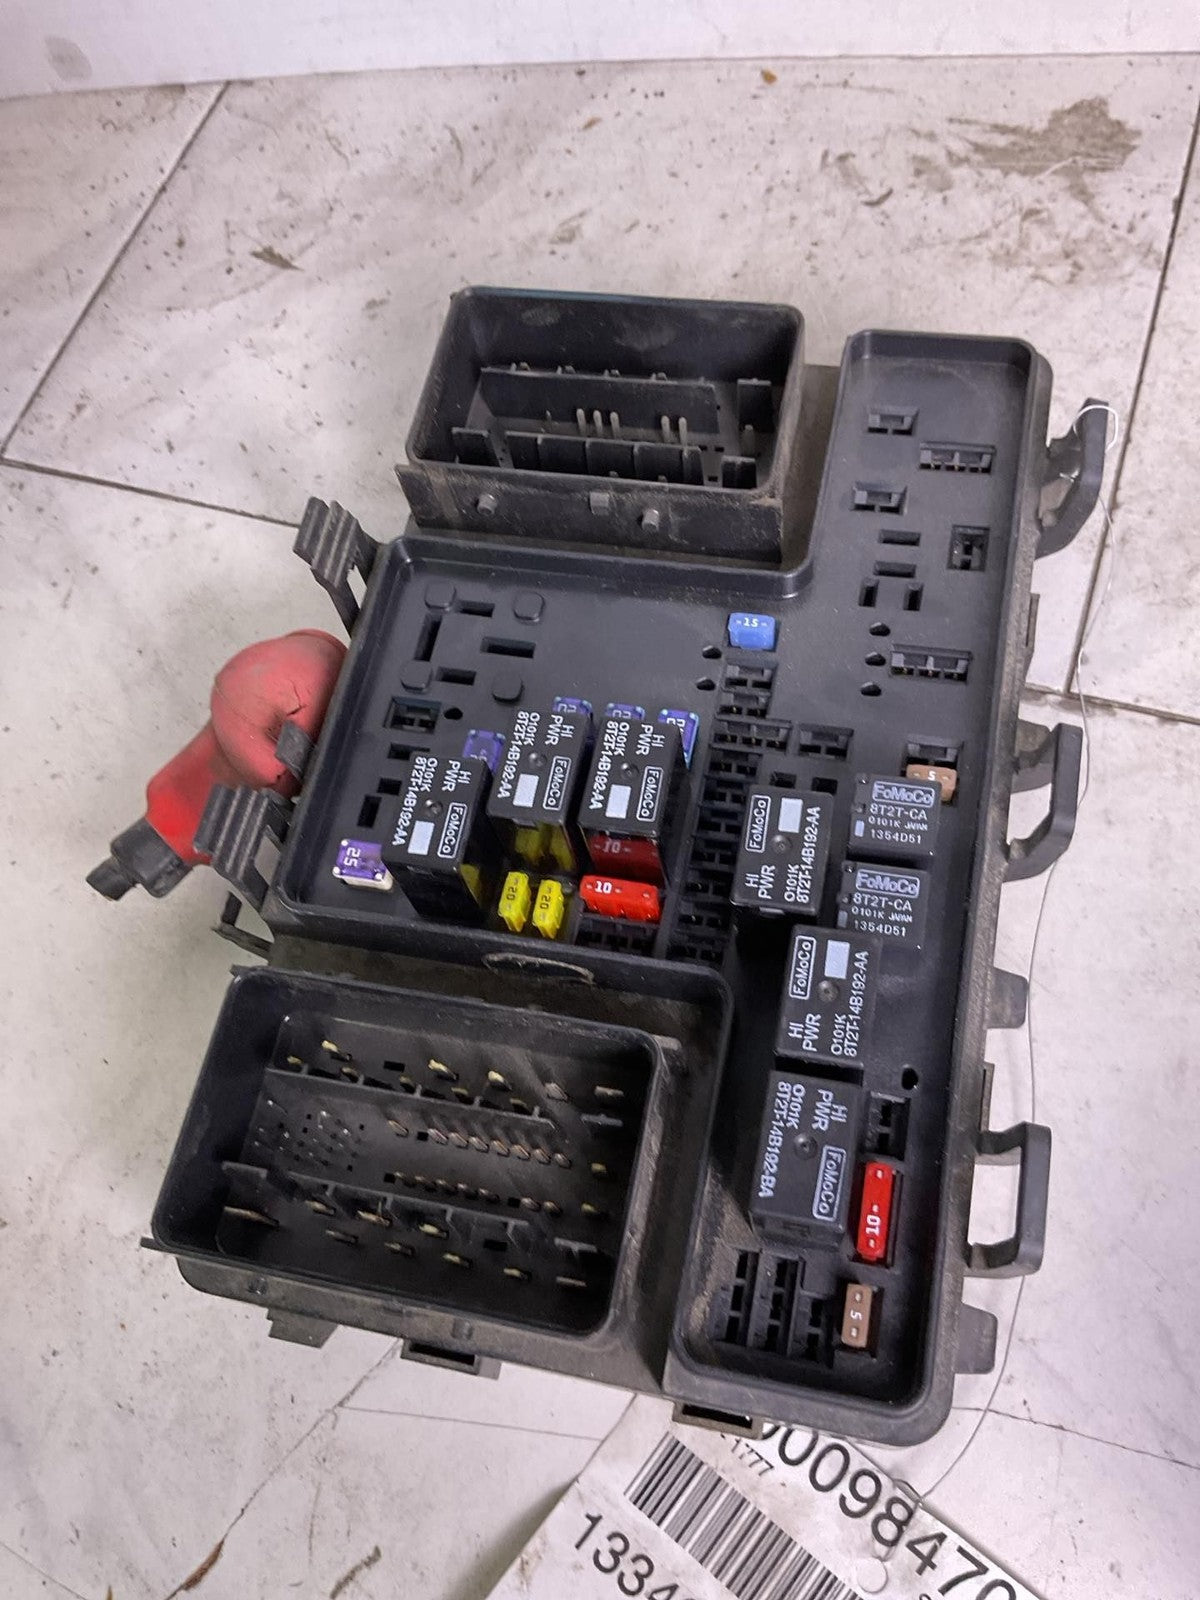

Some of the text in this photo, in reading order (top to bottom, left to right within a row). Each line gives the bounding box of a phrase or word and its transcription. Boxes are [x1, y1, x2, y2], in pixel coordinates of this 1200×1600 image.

[545, 715, 563, 745] PWR
[561, 724, 574, 739] HI
[636, 724, 653, 756] PWR
[652, 733, 666, 748] HI
[497, 711, 530, 798] 8T2T-14B192-AA
[589, 720, 619, 809] 8T2T-14B192-AA
[442, 760, 460, 792] PWR
[458, 769, 472, 784] HI
[546, 759, 569, 807] FoMoCo
[392, 756, 427, 846] 8T2T-14B192-AA
[640, 769, 661, 818] FoMoCo
[874, 783, 933, 804] FoMoCo
[749, 799, 767, 850] FoMoCo
[870, 804, 927, 820] 8T2T-CA
[441, 805, 465, 854] FoMoCo
[871, 829, 921, 844] 1354D51
[344, 847, 361, 867] 25
[797, 806, 821, 903] 8T2T-14B192-AA
[594, 881, 612, 894] 10
[745, 873, 758, 887] HI
[758, 865, 775, 899] PWR
[857, 872, 918, 895] FoMoCo
[853, 893, 912, 911] 8T2T-CA
[854, 920, 906, 936] 1354D51
[793, 940, 811, 996] FoMoCo
[844, 951, 869, 1057] 8T2T-14B192-AA
[788, 1023, 804, 1039] HI
[803, 1014, 822, 1052] PWR
[811, 1089, 834, 1131] PWR
[832, 1105, 847, 1124] HI
[759, 1081, 790, 1198] 8T2T-14B192-BA
[816, 1150, 844, 1216] FoMoCo
[865, 1214, 881, 1236] 10
